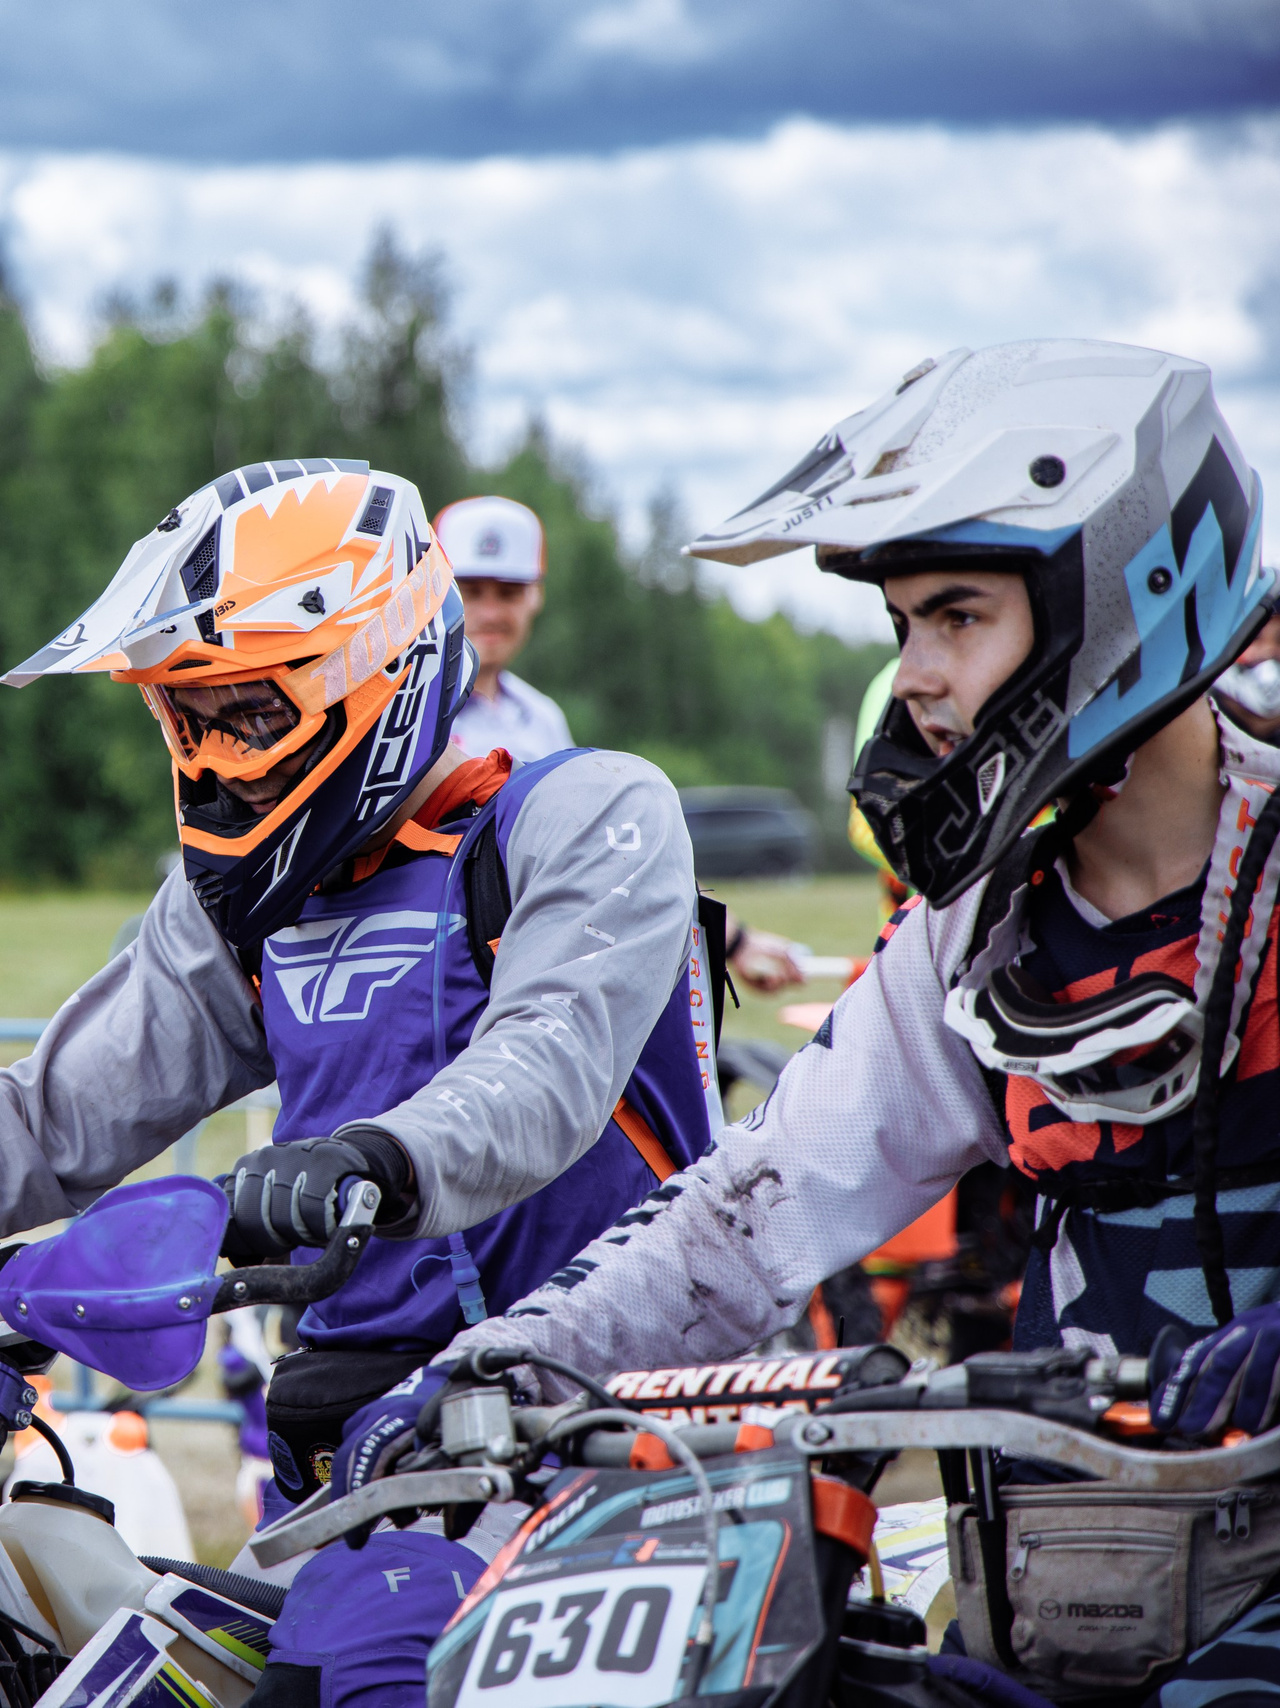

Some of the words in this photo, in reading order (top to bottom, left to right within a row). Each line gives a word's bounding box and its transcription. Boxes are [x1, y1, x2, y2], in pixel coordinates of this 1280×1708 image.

[310, 555, 444, 706] 100%
[436, 1042, 529, 1121] FLY
[603, 1356, 842, 1400] RENTHAL
[352, 1456, 369, 1492] PERC
[361, 1434, 381, 1456] 100
[477, 1586, 673, 1690] 630
